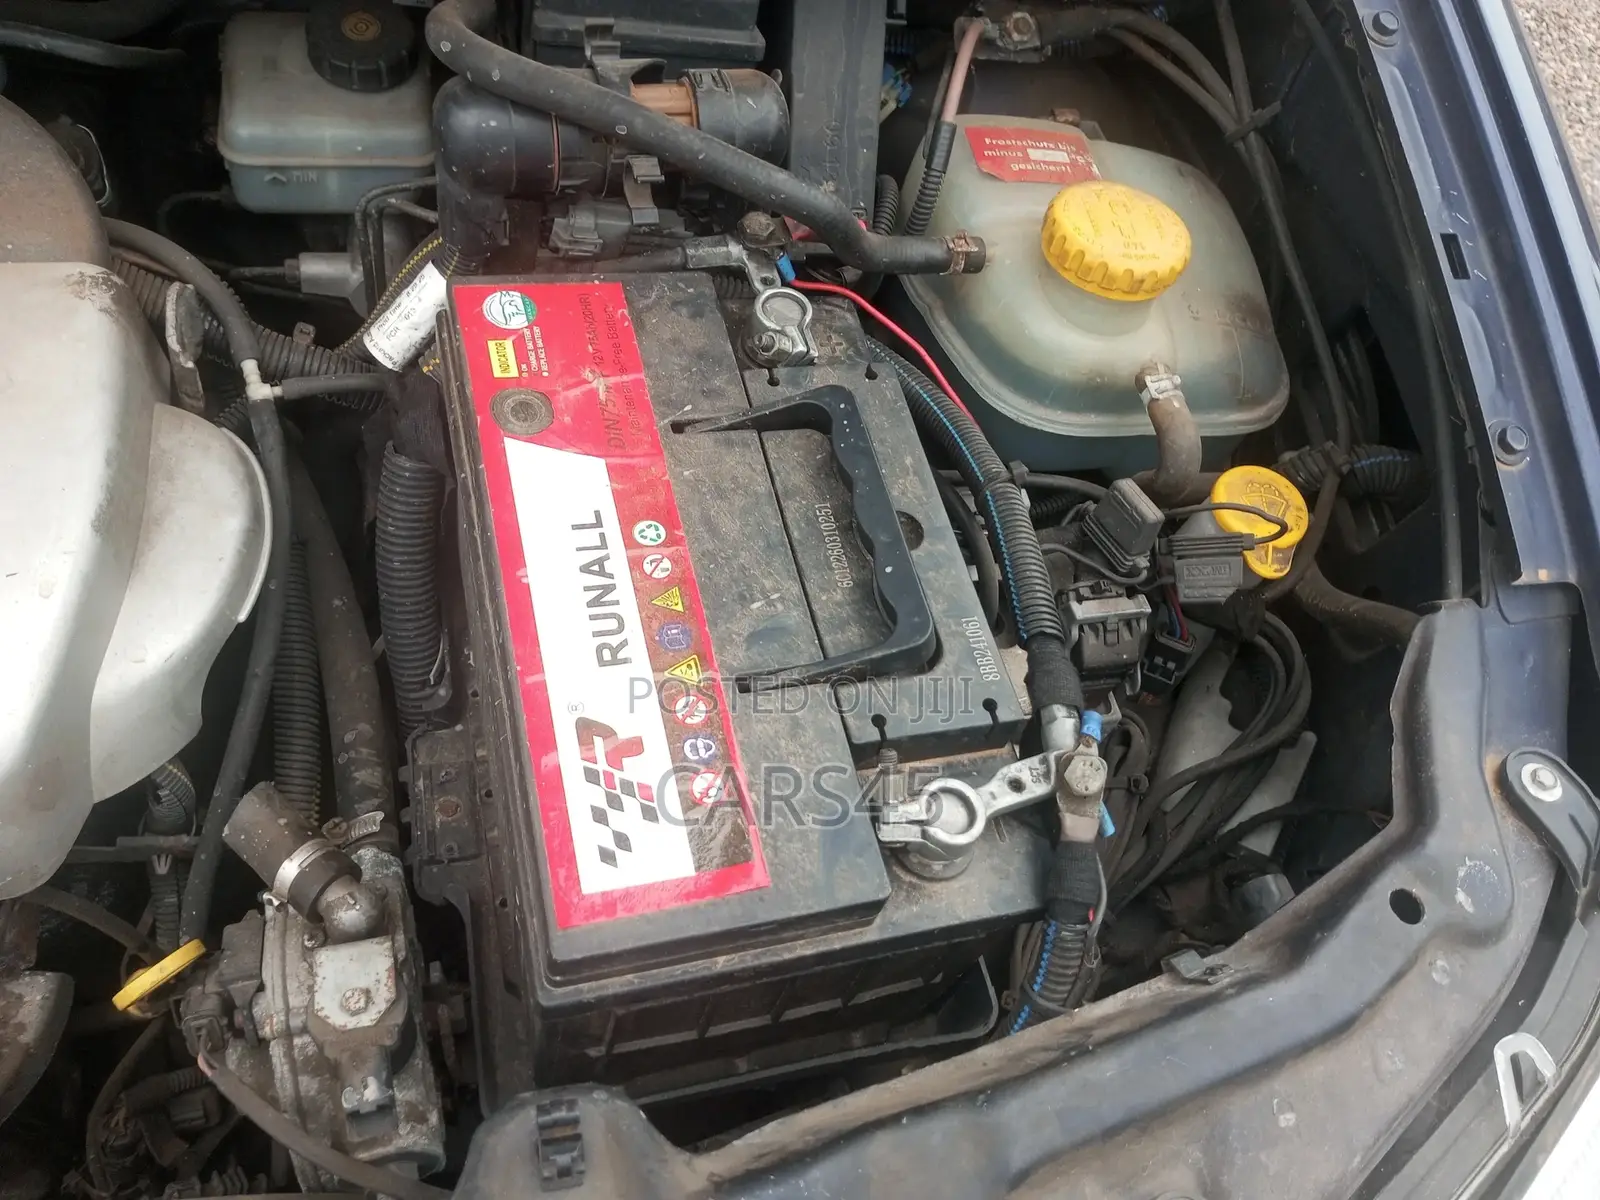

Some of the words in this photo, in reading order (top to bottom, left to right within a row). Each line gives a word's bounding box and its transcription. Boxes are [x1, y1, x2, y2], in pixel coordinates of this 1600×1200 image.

[984, 149, 1023, 157] minus
[495, 341, 511, 374] INDICATOR
[571, 509, 632, 668] RUNALL
[961, 615, 1000, 682] 8BB241061
